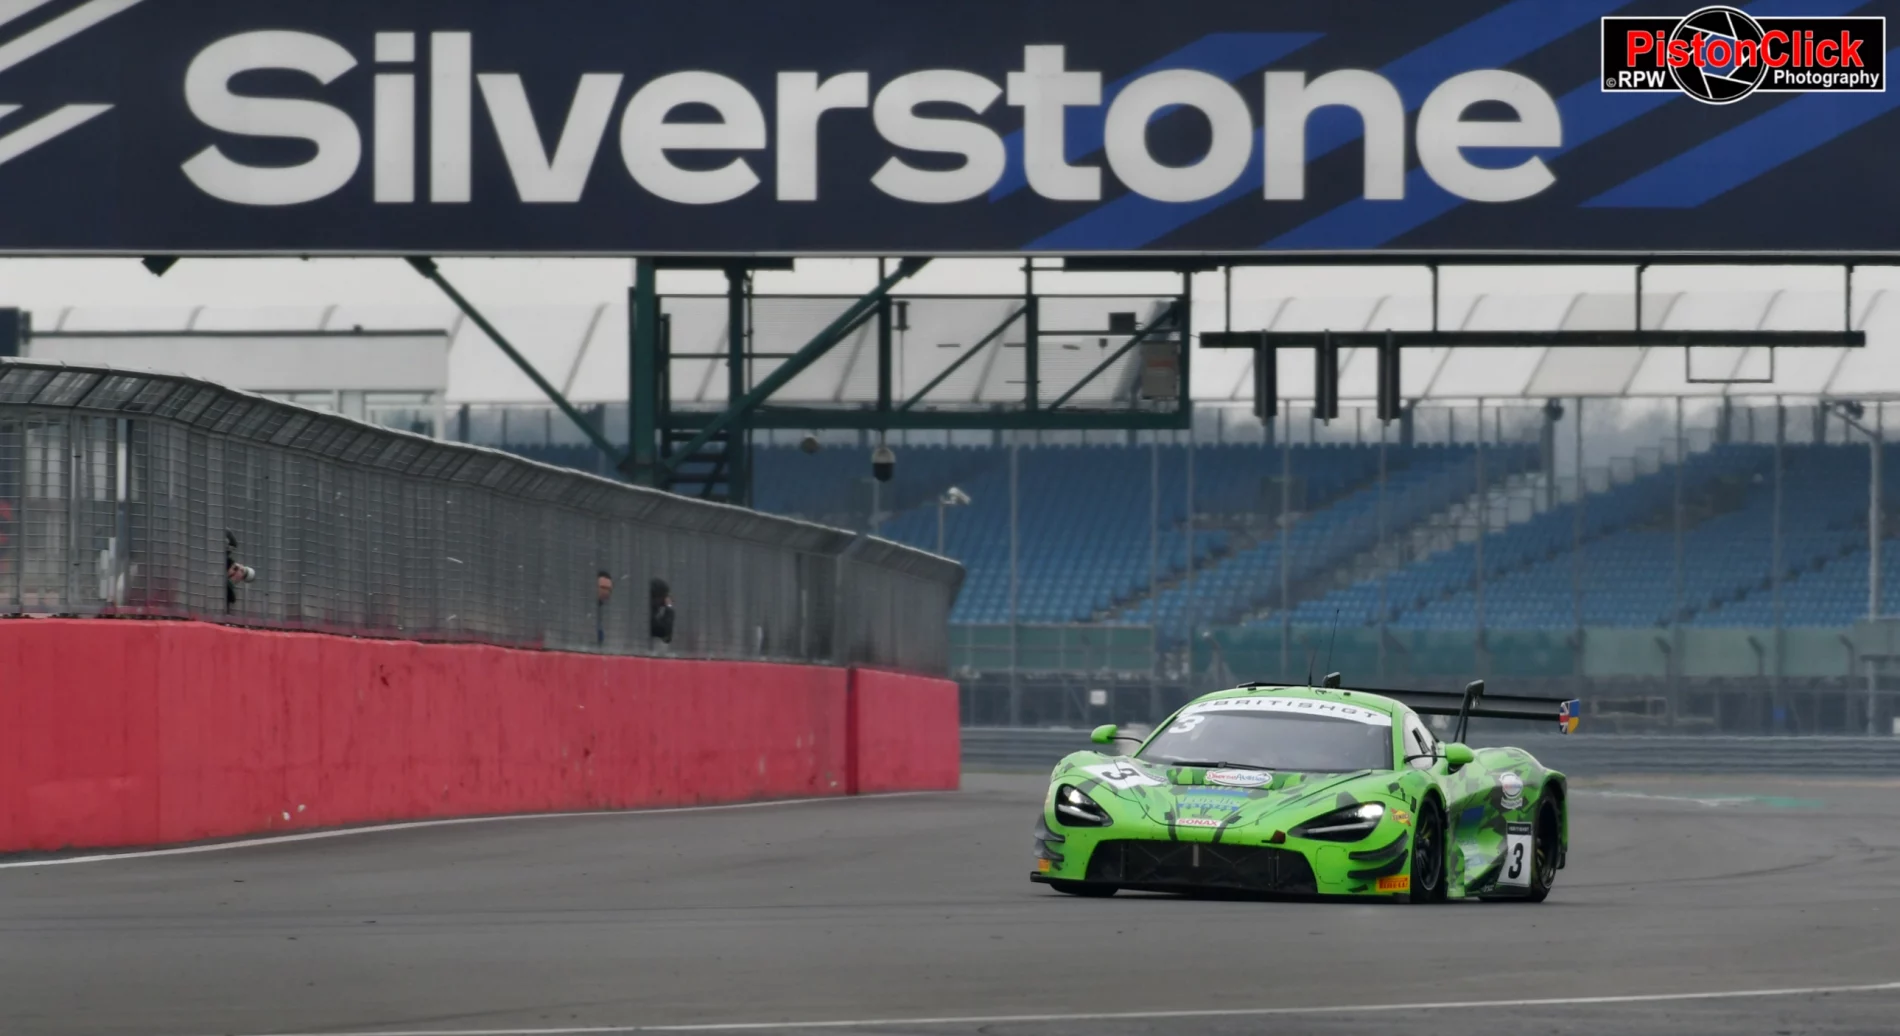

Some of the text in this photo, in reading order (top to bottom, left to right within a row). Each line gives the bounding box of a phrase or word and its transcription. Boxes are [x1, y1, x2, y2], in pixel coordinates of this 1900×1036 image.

[180, 30, 1562, 205] Silverstone
[1168, 714, 1205, 734] 3
[1101, 768, 1140, 781] 3
[1508, 842, 1524, 879] 3
